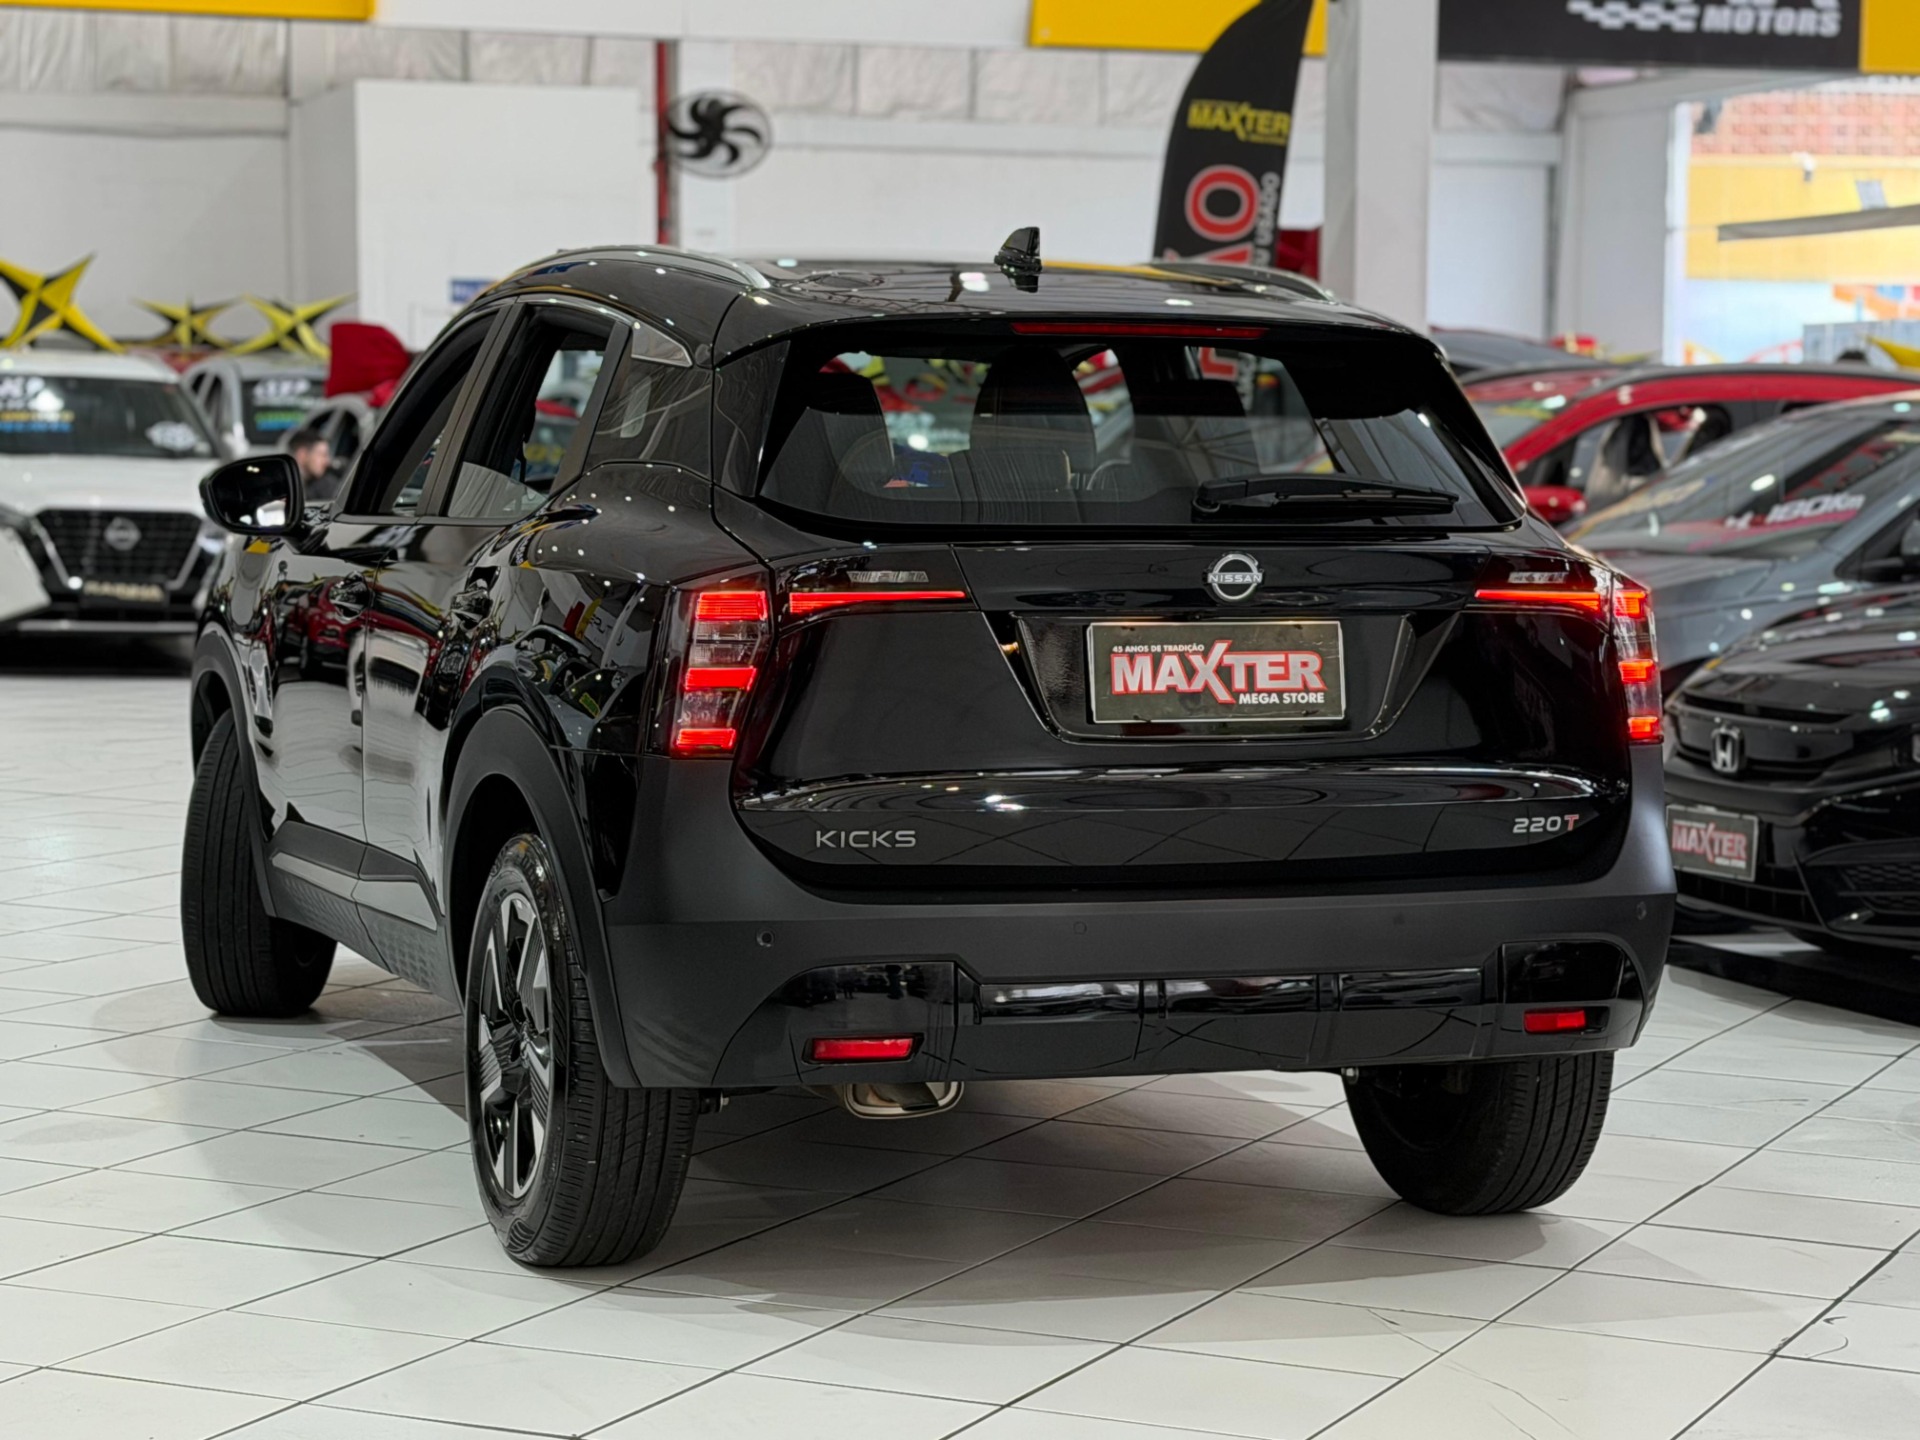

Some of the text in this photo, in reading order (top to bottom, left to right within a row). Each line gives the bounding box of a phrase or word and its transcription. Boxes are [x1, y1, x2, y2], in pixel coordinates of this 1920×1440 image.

[1701, 6, 1841, 37] MOTORS
[1188, 102, 1291, 141] MAXTER
[1209, 574, 1261, 583] NISSAN
[1112, 645, 1123, 653] 45
[1125, 645, 1149, 653] ANOS
[1163, 643, 1205, 652] TRADIÇÃO
[1111, 641, 1327, 704] MAXTER
[1239, 692, 1325, 704] MEGA STORE
[1512, 814, 1580, 834] 220T
[816, 830, 916, 848] KICKS
[1672, 822, 1748, 864] MAXTER
